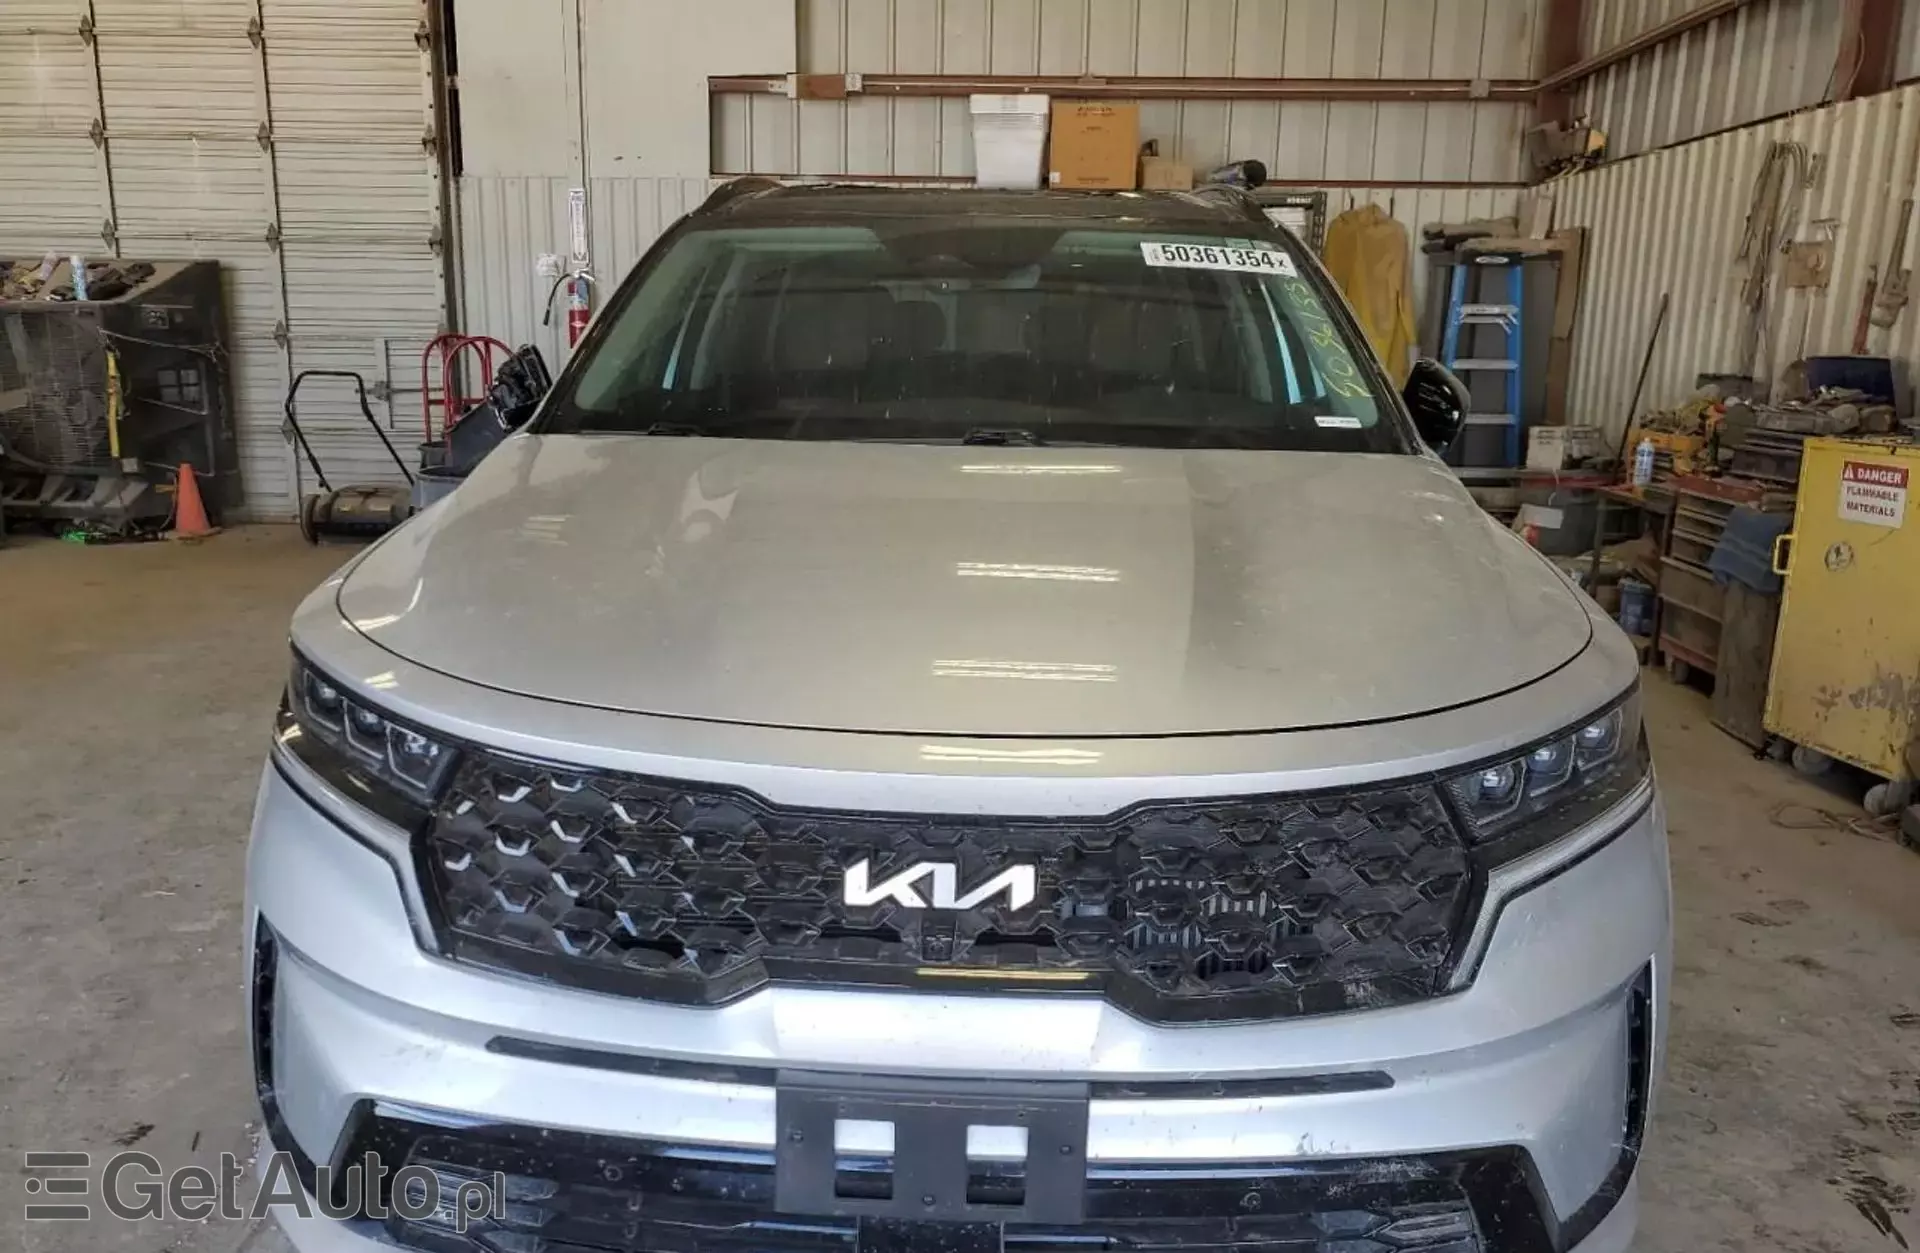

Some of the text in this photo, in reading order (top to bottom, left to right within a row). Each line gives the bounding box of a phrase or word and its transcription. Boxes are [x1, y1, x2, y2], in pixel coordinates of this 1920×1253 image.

[1160, 244, 1276, 269] 50361354
[1857, 468, 1902, 484] DANGER
[1846, 486, 1899, 501] FLAMMABLE
[1846, 501, 1895, 517] MATERIALS
[844, 857, 1036, 913] KIA
